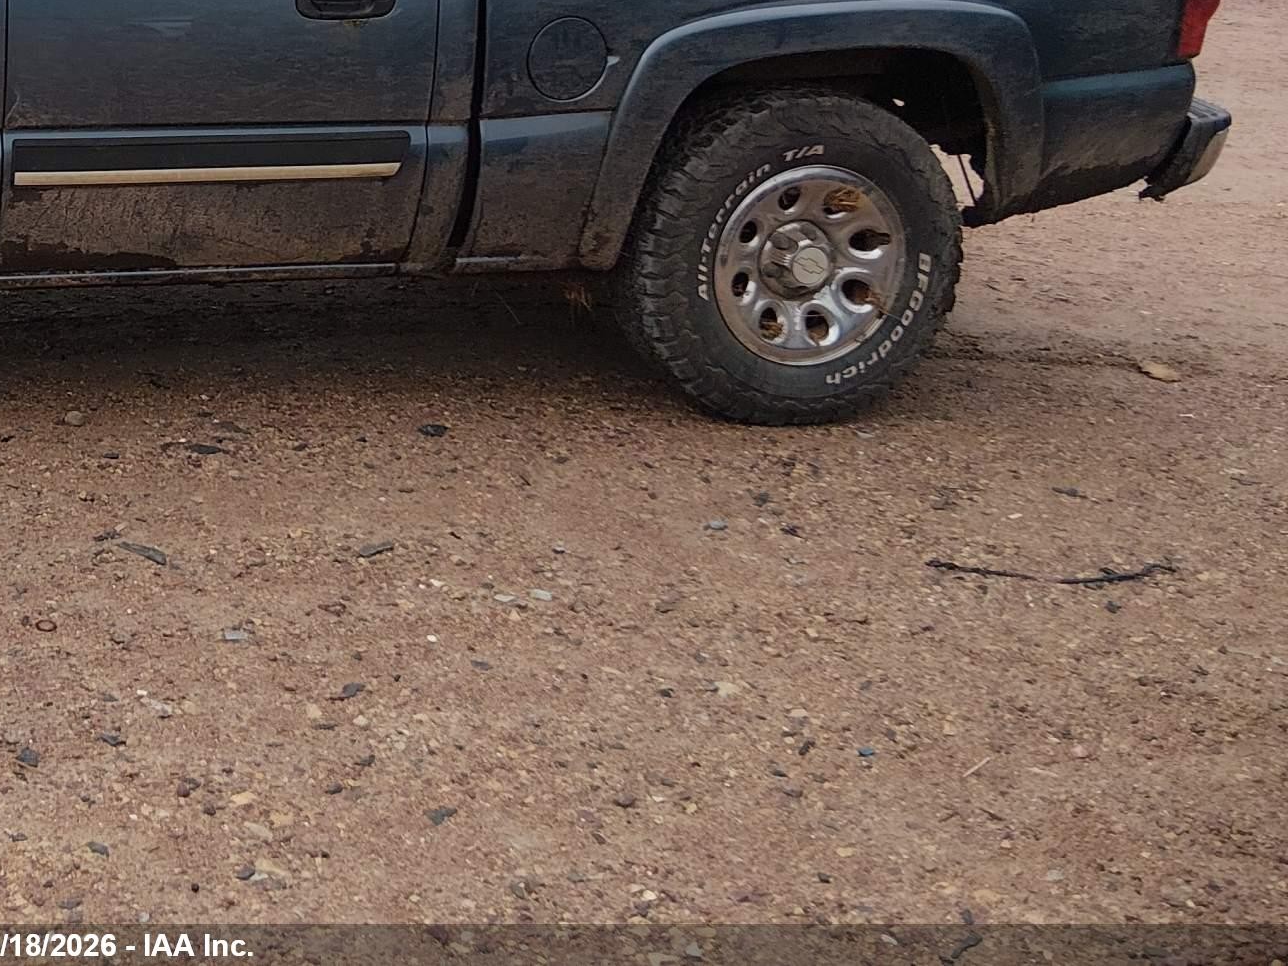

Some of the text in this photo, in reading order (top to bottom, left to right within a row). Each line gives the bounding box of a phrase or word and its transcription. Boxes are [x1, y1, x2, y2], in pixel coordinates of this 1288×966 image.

[697, 144, 826, 302] All-Terrain T/A
[825, 251, 935, 386] BFGoodrich
